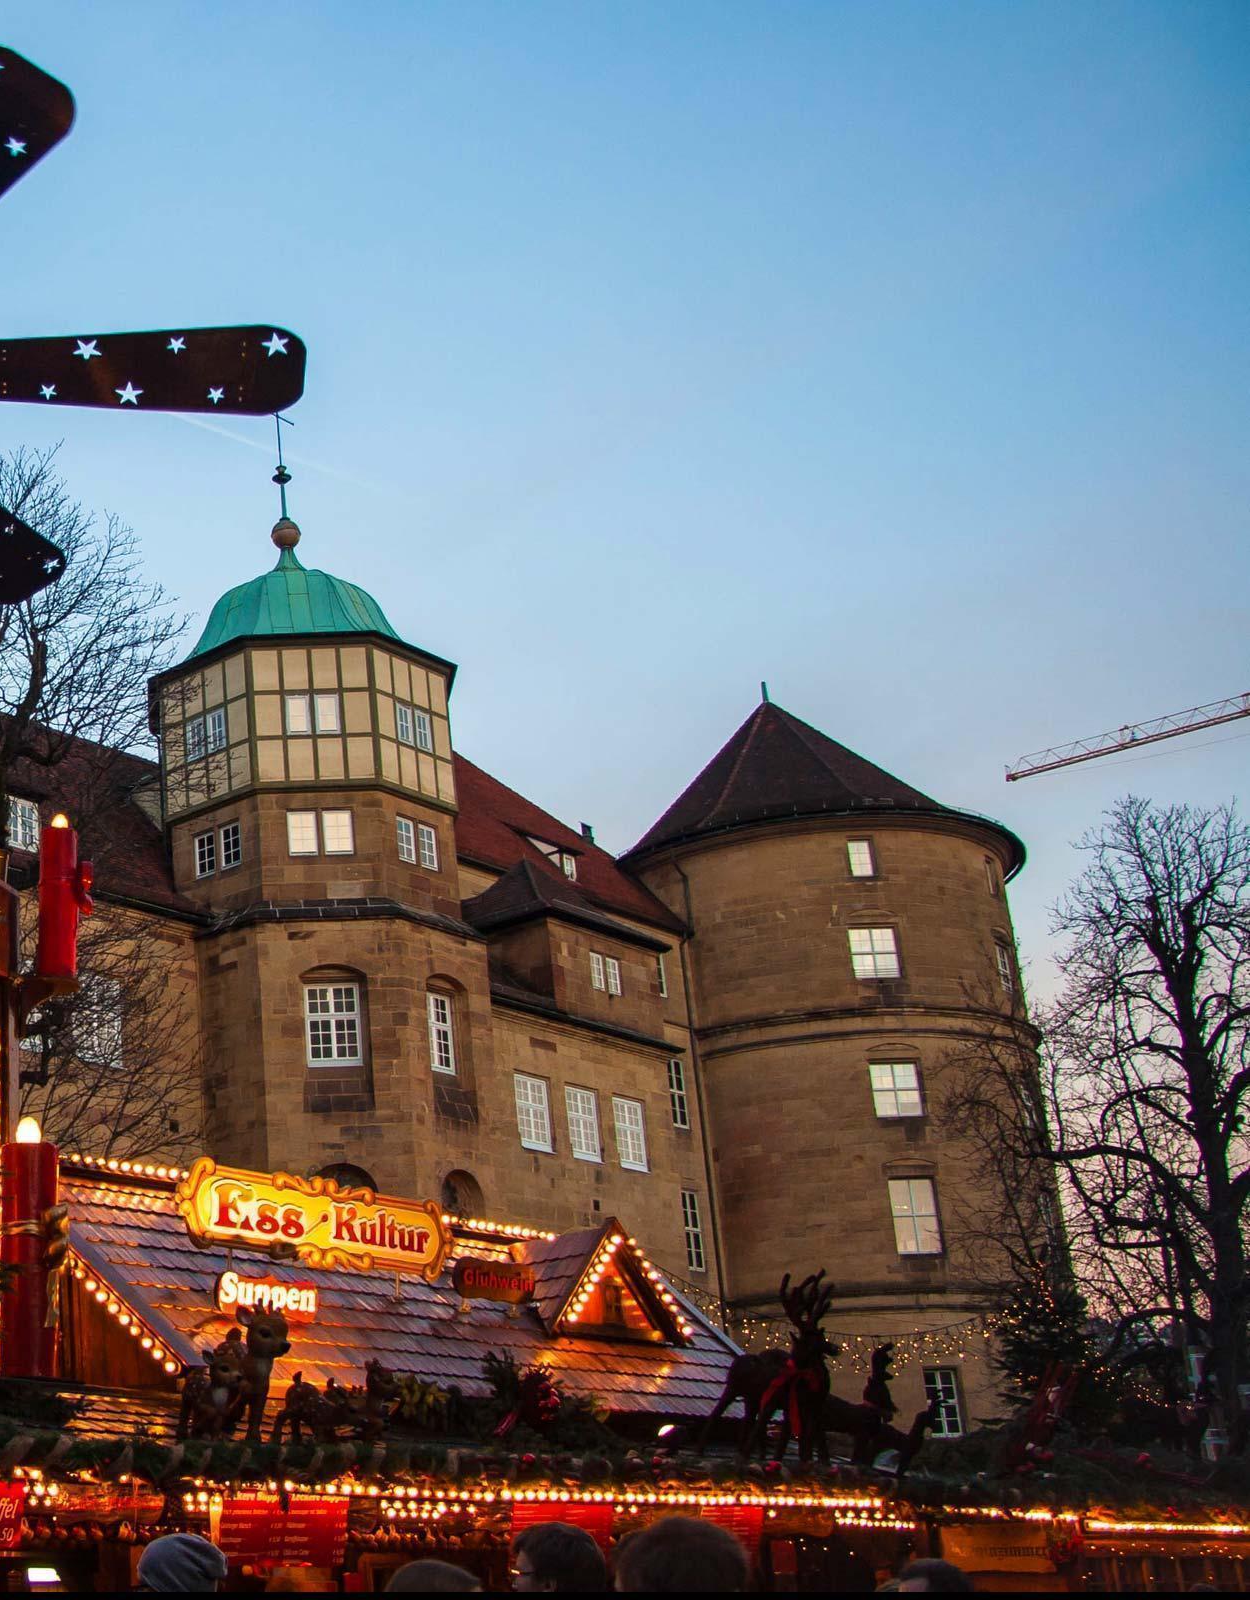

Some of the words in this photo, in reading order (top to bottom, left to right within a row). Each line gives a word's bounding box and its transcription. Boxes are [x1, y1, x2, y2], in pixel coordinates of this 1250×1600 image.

[213, 1178, 306, 1239] Ess
[331, 1201, 430, 1255] Kultur
[219, 1271, 317, 1313] Suppen
